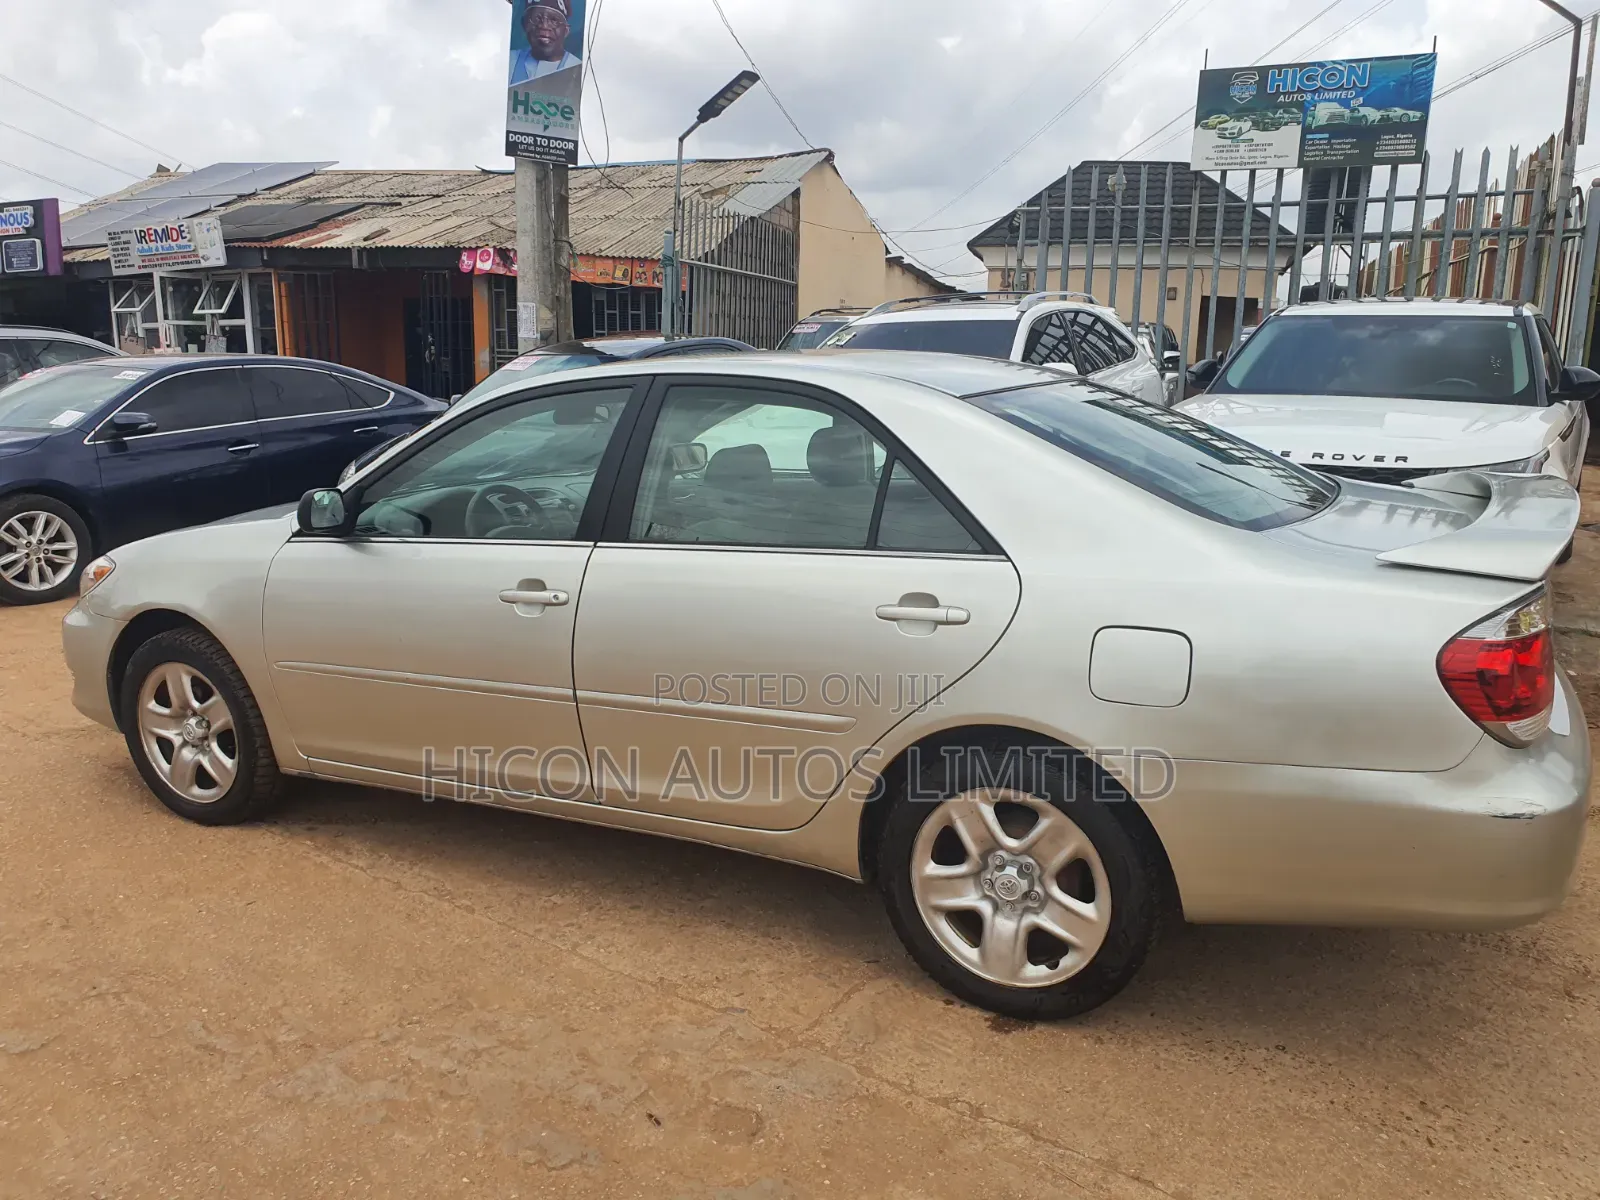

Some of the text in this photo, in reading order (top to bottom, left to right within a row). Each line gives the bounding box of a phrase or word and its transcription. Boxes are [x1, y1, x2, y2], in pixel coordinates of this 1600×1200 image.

[1267, 62, 1371, 93] HICON
[512, 90, 575, 121] Hope
[1277, 90, 1356, 103] AUTOS LIMITED
[509, 133, 575, 151] DOOR TO DOOR
[134, 224, 187, 244] IREMIDE
[136, 244, 153, 254] Adult
[161, 244, 174, 252] Kids
[176, 243, 192, 251] Store
[1312, 452, 1409, 463] ROVER
